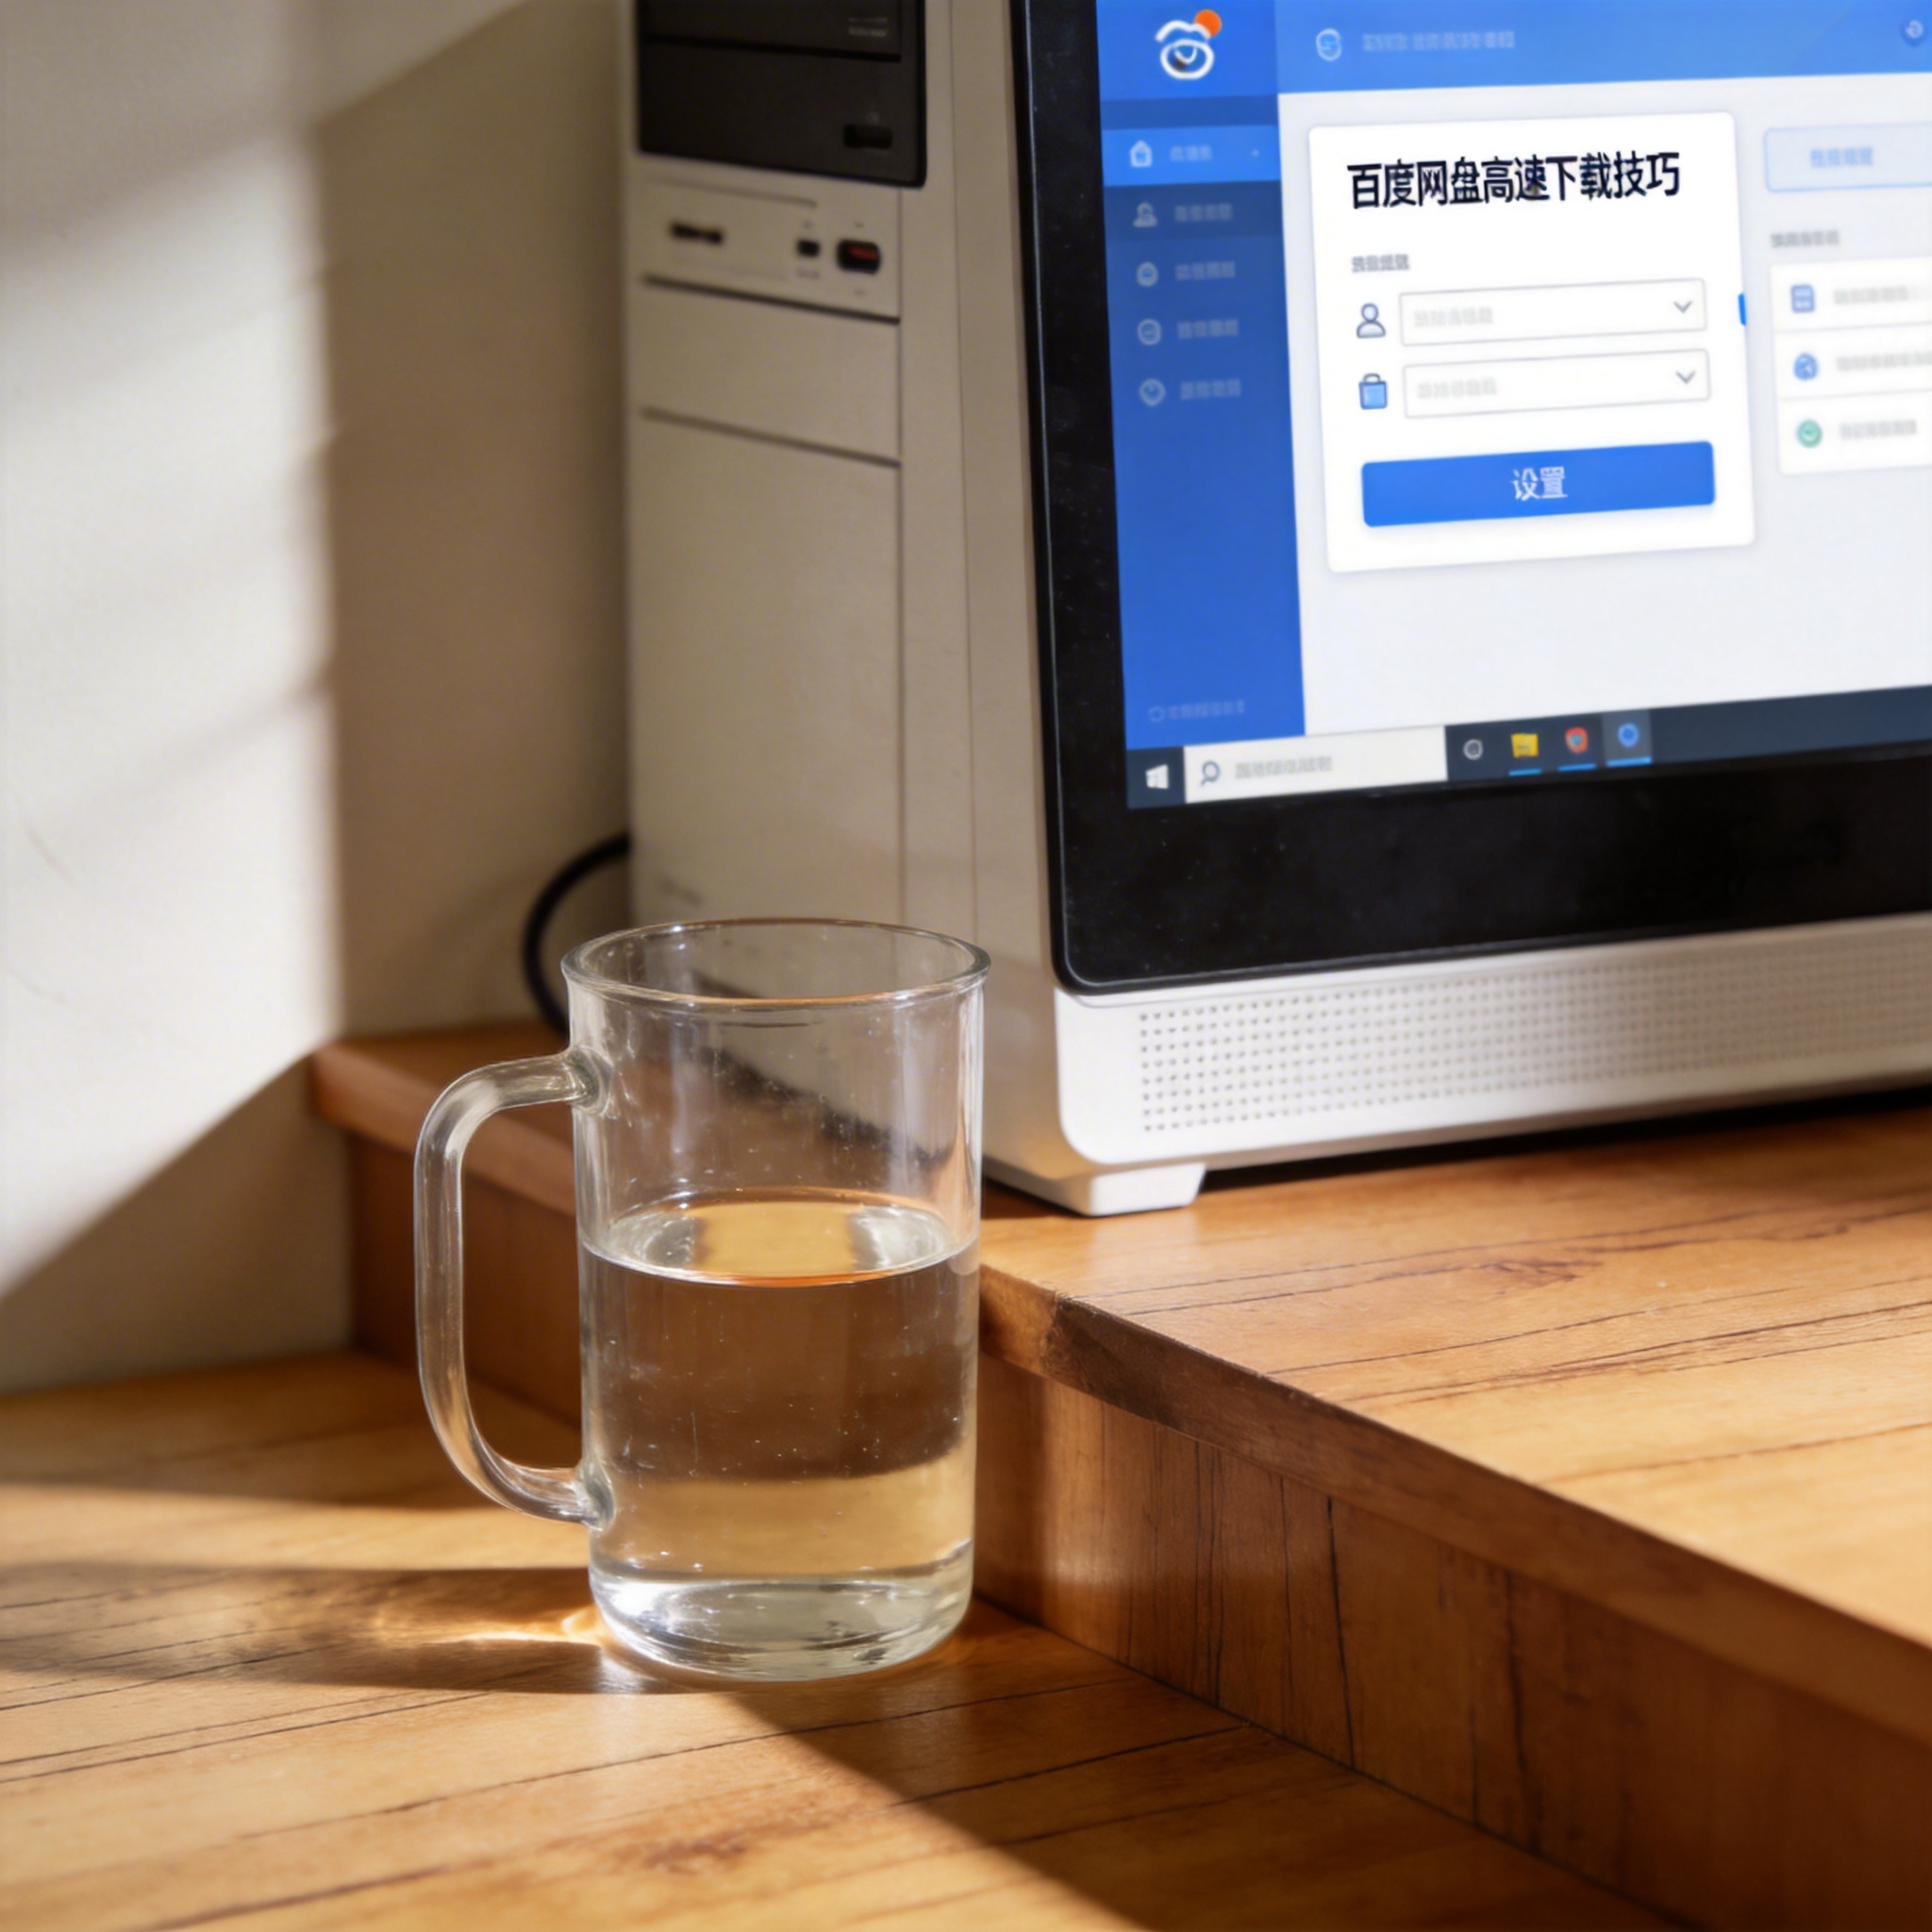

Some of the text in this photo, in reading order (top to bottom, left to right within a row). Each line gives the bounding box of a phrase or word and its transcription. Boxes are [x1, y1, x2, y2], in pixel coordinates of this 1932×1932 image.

[1347, 151, 1680, 209] 百度网盘高速下载技巧
[1511, 466, 1568, 501] 设置
